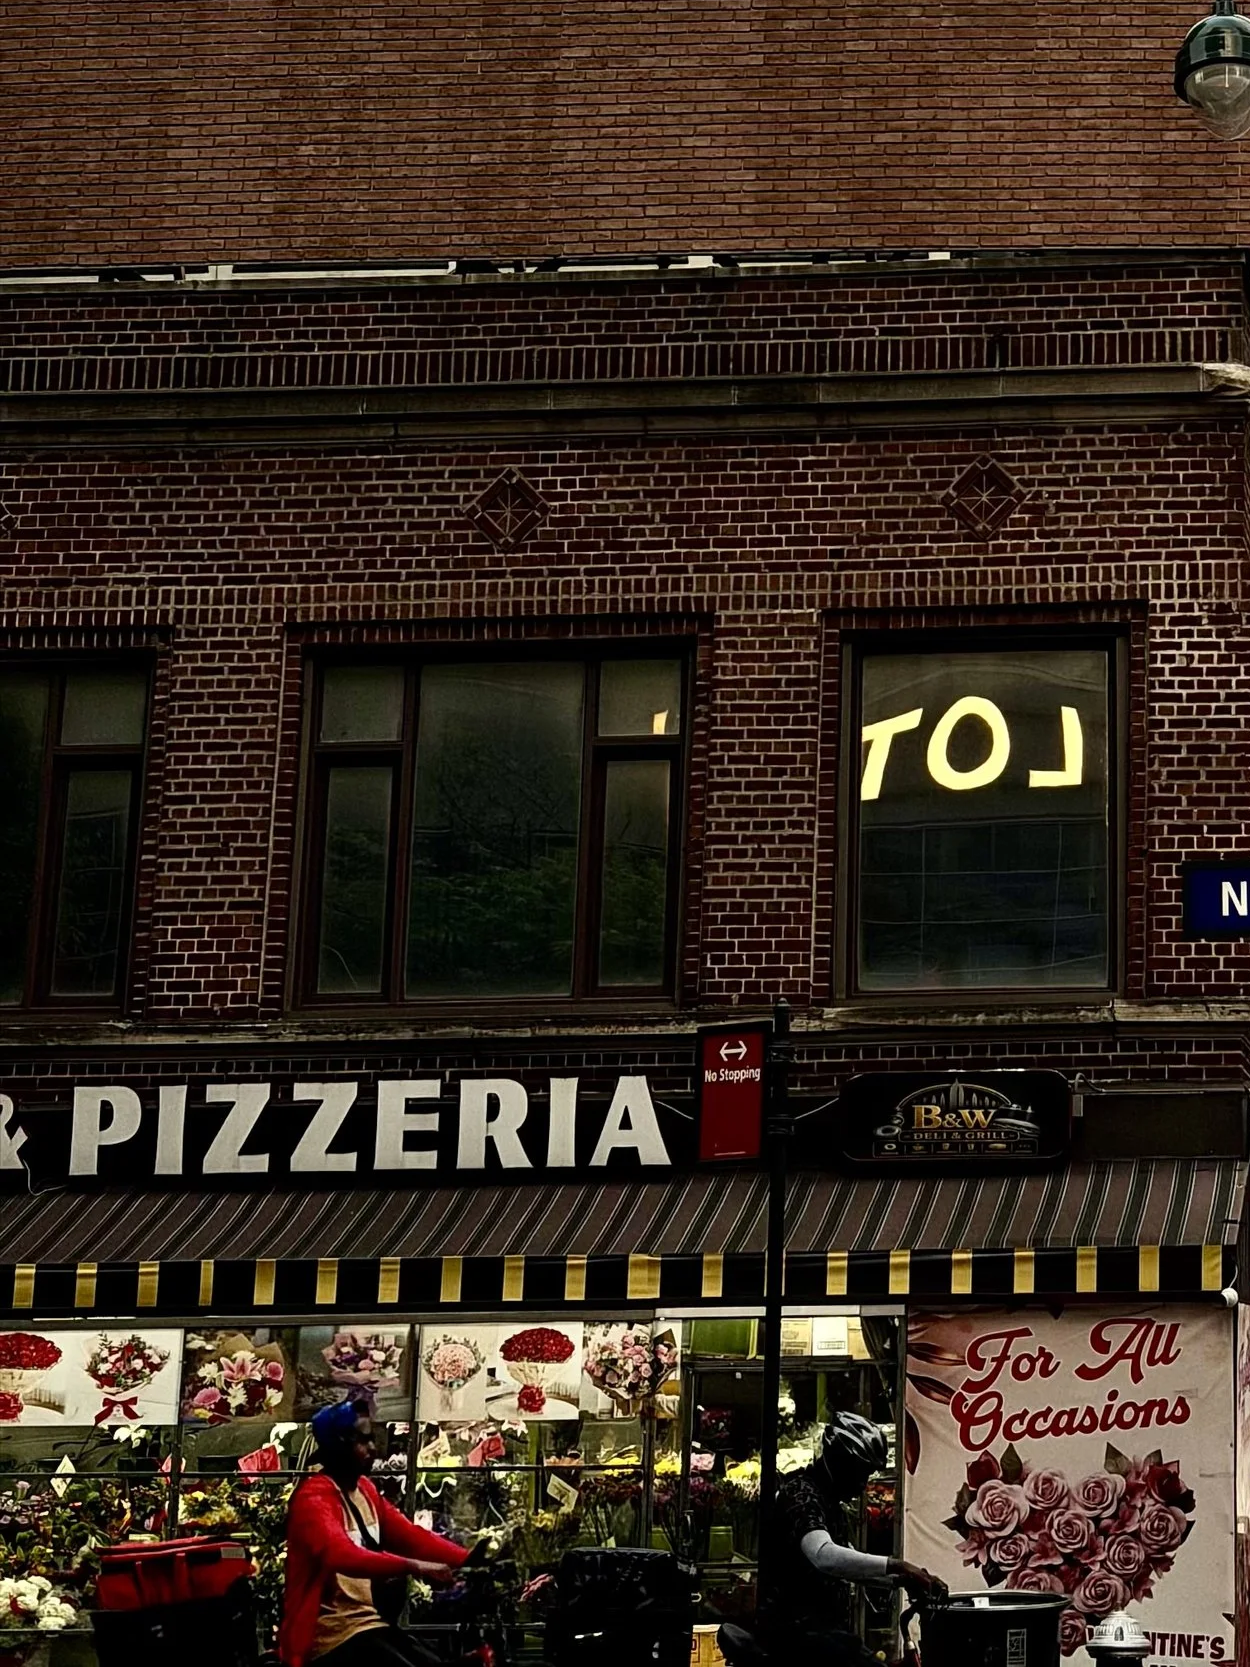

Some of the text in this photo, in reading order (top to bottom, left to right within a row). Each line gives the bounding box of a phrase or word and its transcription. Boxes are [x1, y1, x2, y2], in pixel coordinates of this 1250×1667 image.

[705, 1066, 761, 1083] No Stopping
[69, 1076, 672, 1175] PIZZERIA
[911, 1105, 997, 1129] B&W
[914, 1132, 947, 1140] DELI
[965, 1131, 1006, 1140] GRILL
[960, 1317, 1182, 1394] For All
[950, 1390, 1191, 1452] Occasions
